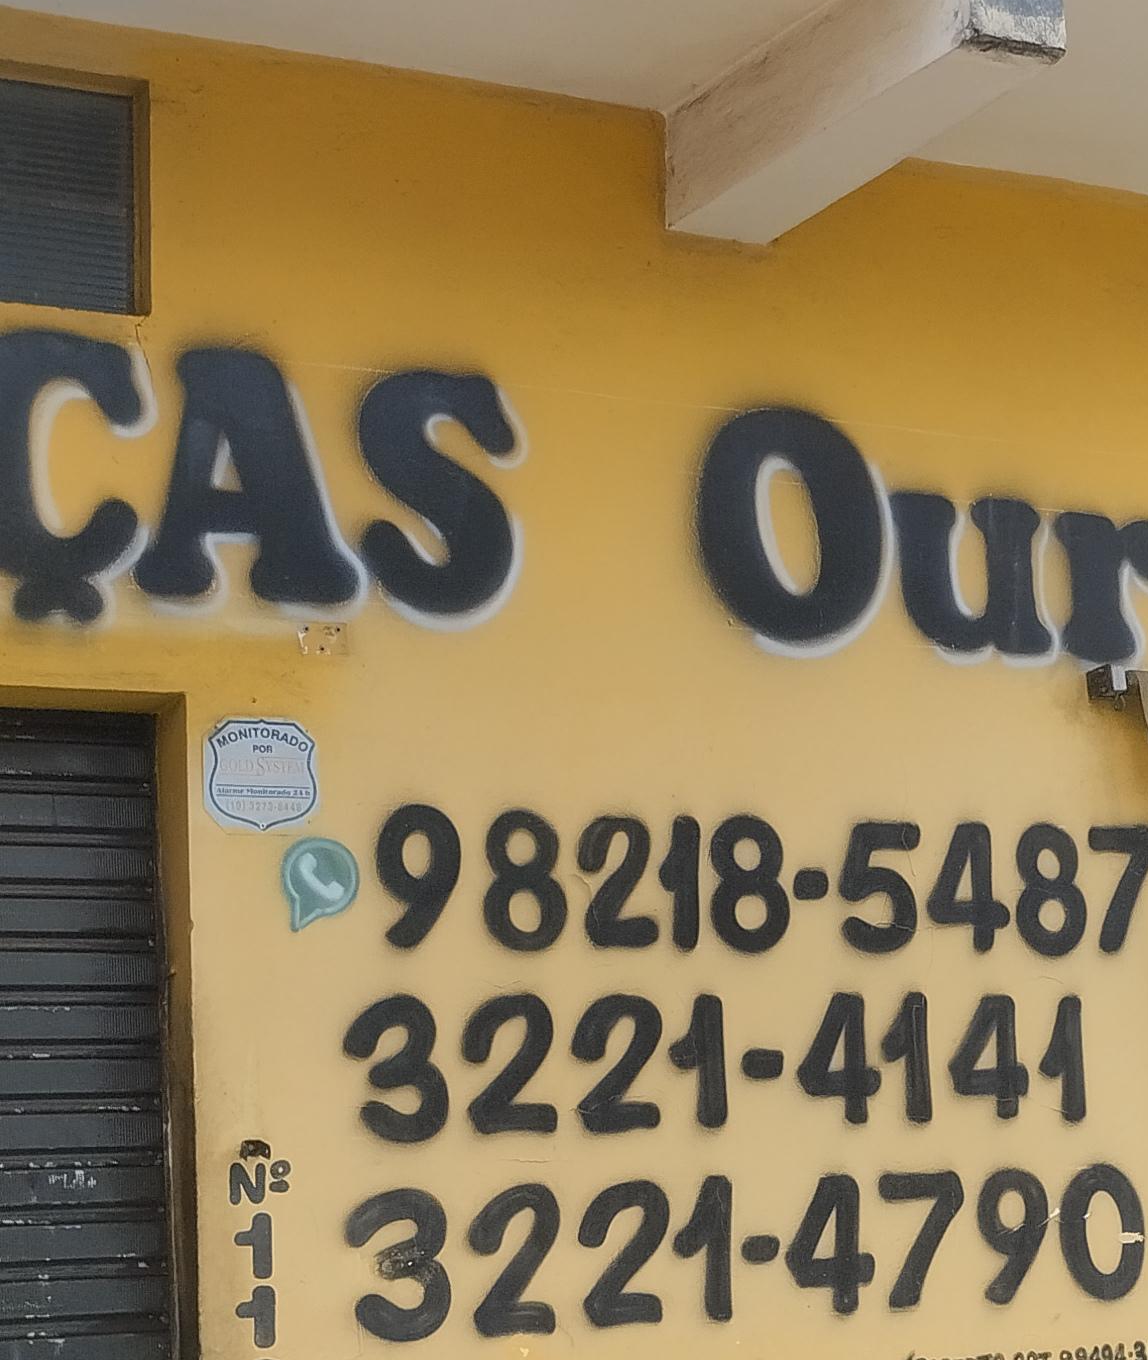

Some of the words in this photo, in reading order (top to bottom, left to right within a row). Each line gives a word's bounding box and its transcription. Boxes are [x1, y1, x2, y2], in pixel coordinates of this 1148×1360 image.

[216, 727, 309, 753] MONITORADO
[252, 744, 273, 754] POR
[342, 991, 1088, 1145] 3221-4141
[346, 1163, 1145, 1343] 3221-4790
